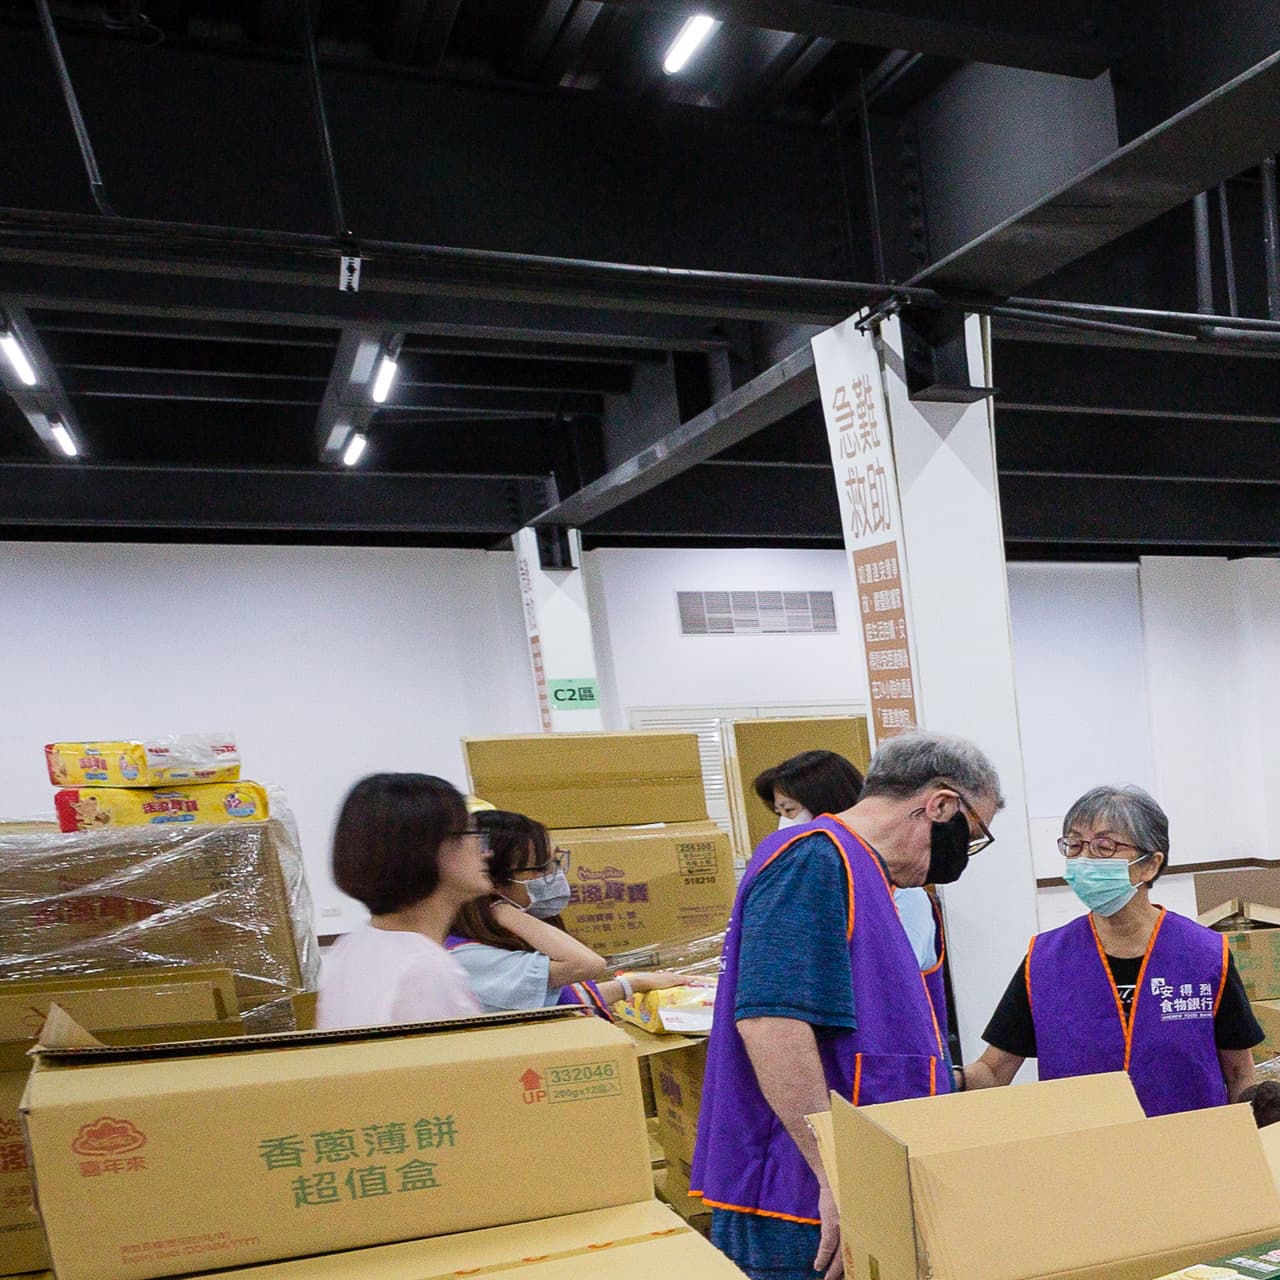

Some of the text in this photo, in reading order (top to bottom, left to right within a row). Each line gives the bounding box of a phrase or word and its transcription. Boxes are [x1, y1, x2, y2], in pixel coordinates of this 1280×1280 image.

[844, 457, 892, 539] 救助
[553, 687, 595, 702] C2區
[1160, 983, 1212, 998] 安得烈
[1160, 997, 1213, 1013] 食物銀行
[551, 1061, 615, 1082] 332046
[522, 1090, 547, 1106] UP
[257, 1114, 459, 1172] 香蔥薄餅
[292, 1159, 443, 1209] 超值盒
